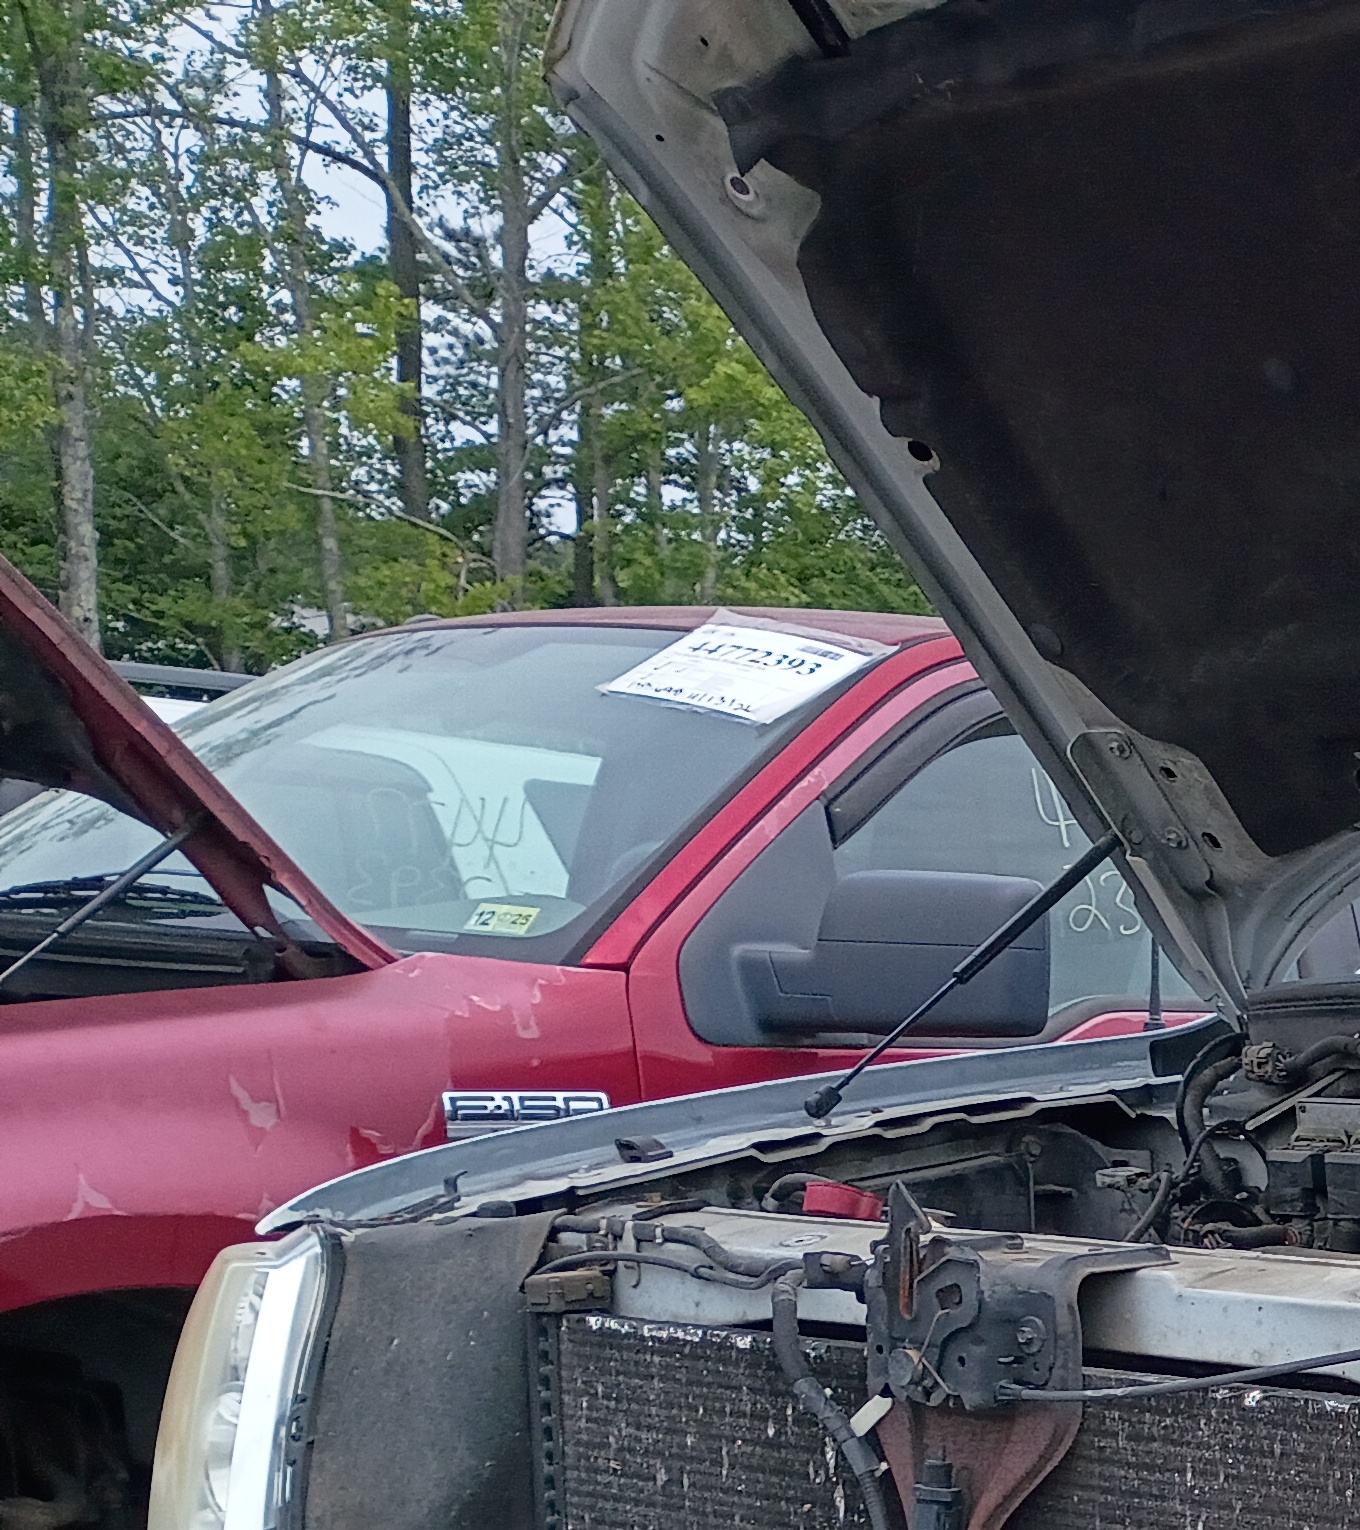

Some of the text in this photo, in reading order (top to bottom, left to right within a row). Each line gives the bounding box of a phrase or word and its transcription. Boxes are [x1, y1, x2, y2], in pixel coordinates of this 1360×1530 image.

[688, 641, 823, 676] 44772393
[472, 910, 533, 927] 12 25
